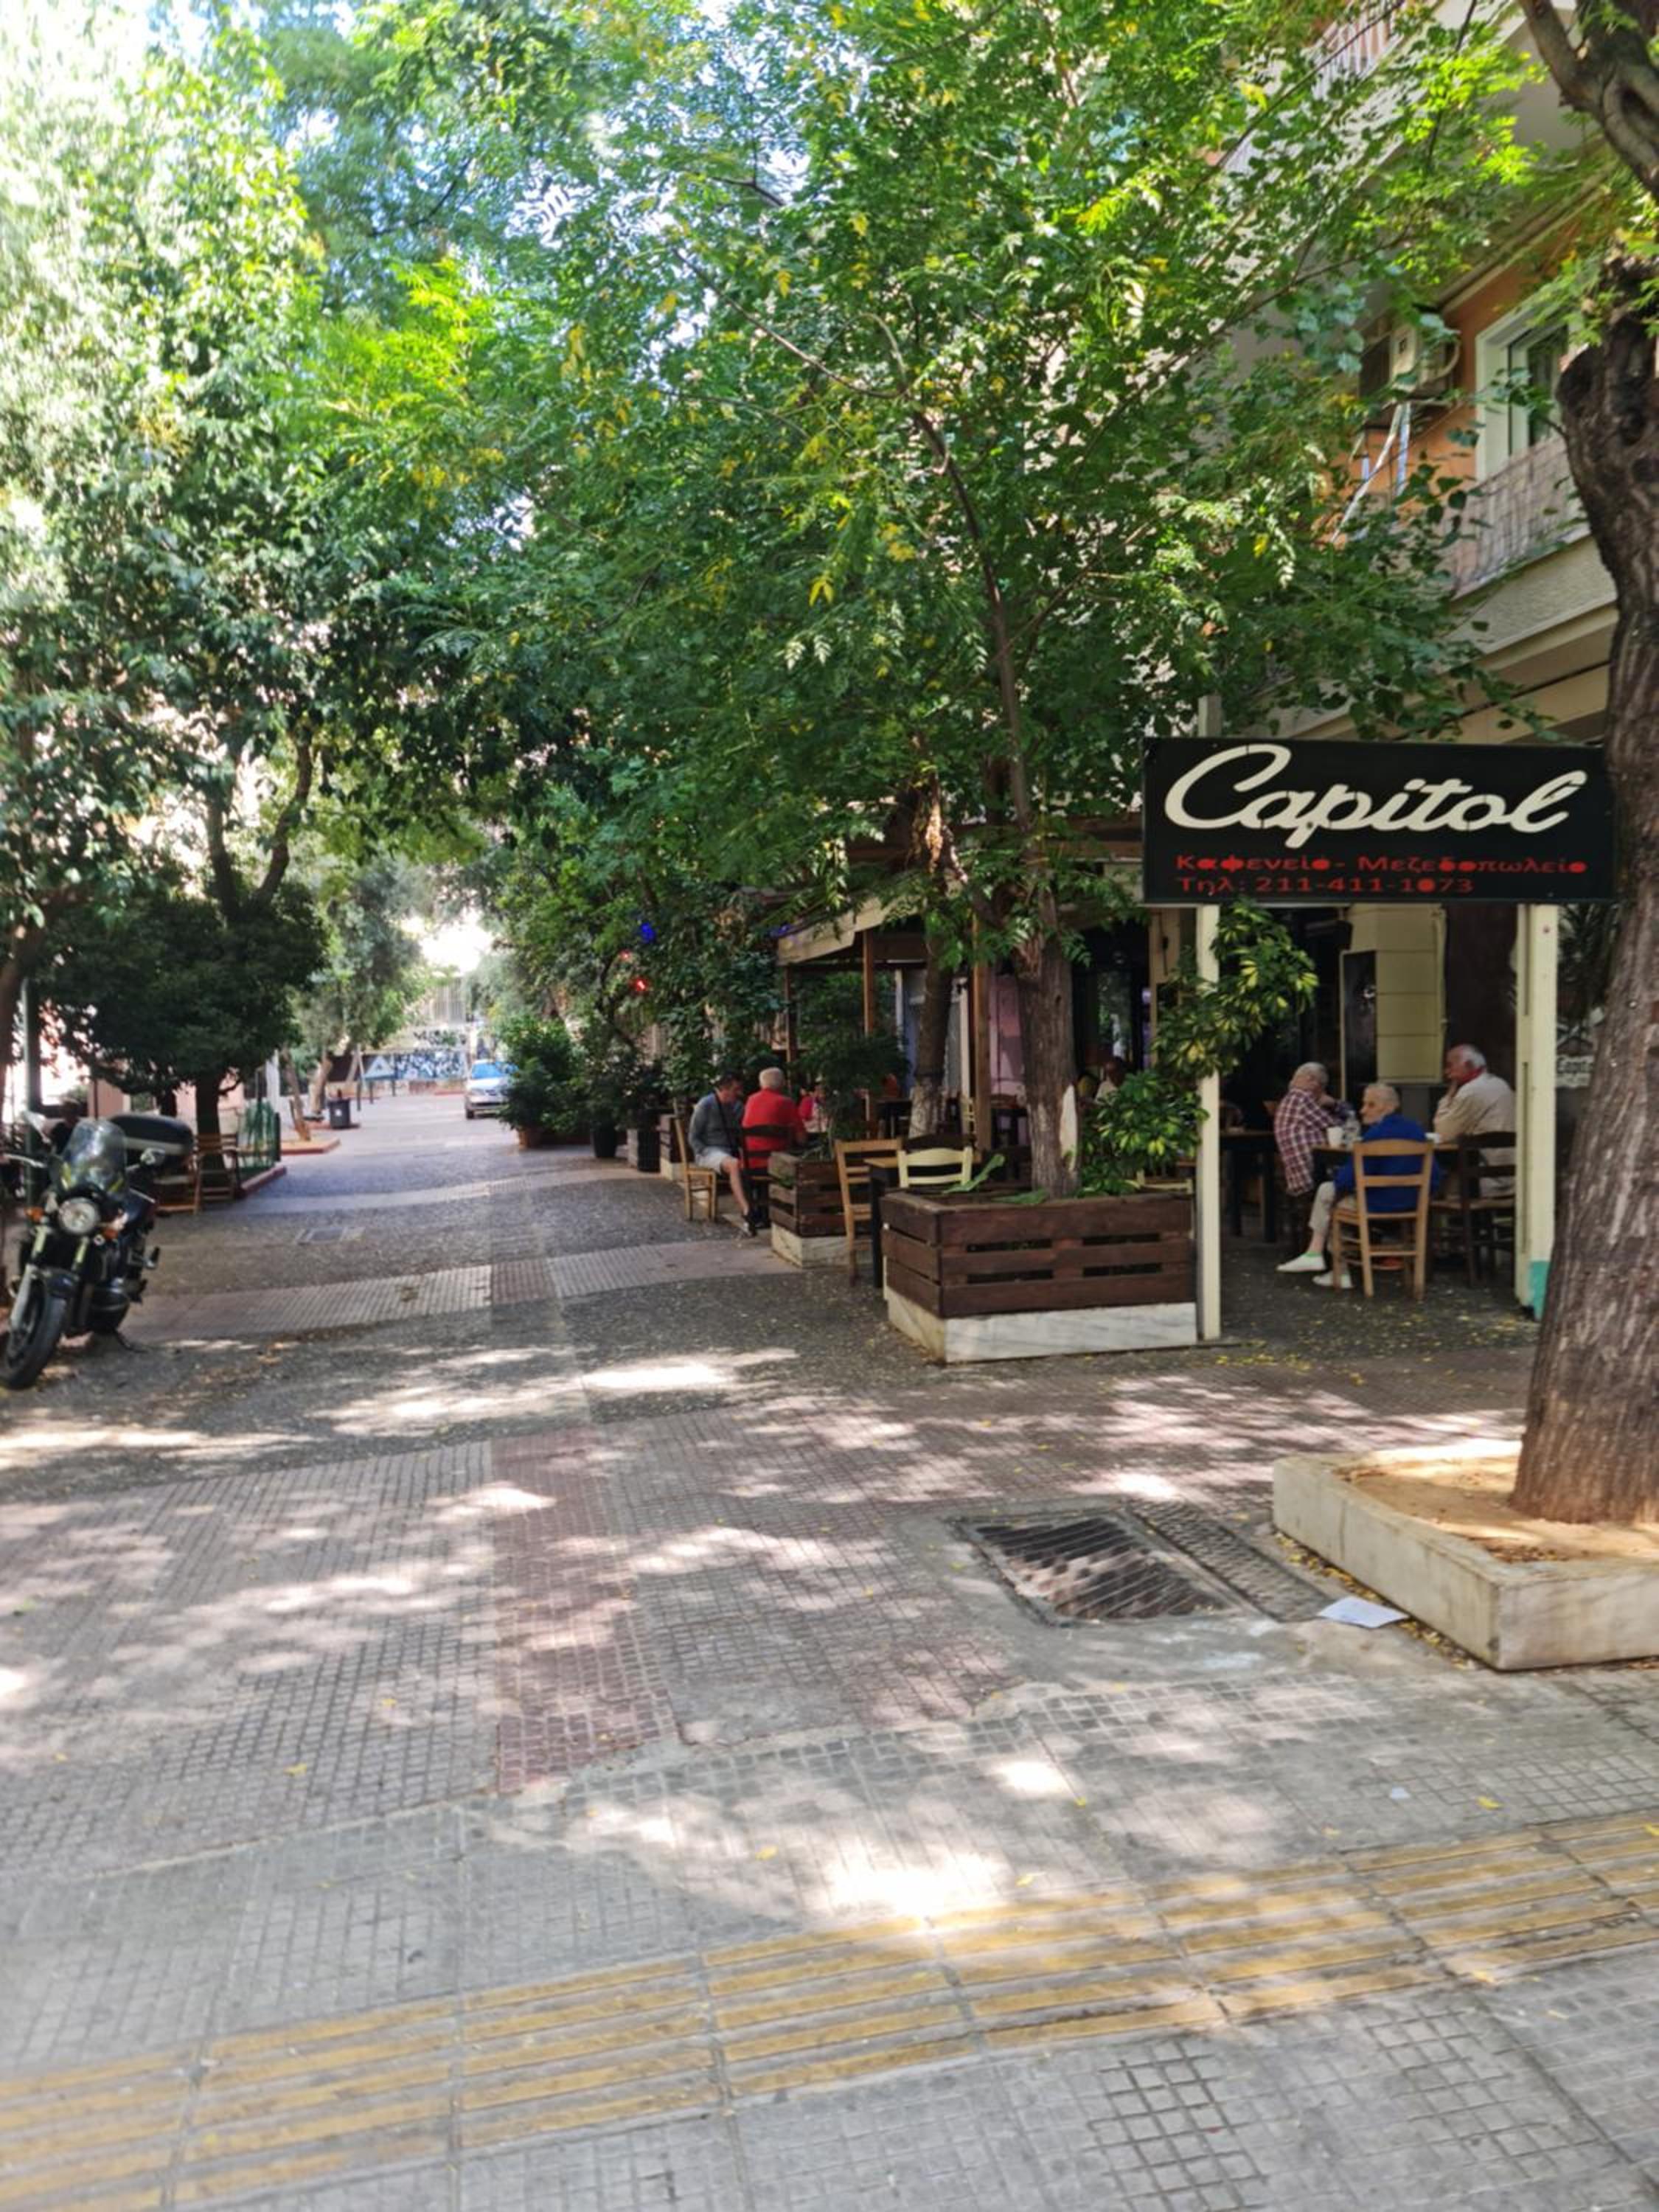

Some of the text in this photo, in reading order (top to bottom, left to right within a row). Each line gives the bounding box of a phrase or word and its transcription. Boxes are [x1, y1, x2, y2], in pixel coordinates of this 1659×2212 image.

[1165, 744, 1587, 848] Capitol
[1356, 855, 1587, 874] Μεζεδοπωλείο
[1256, 877, 1474, 893] 211-411-1073
